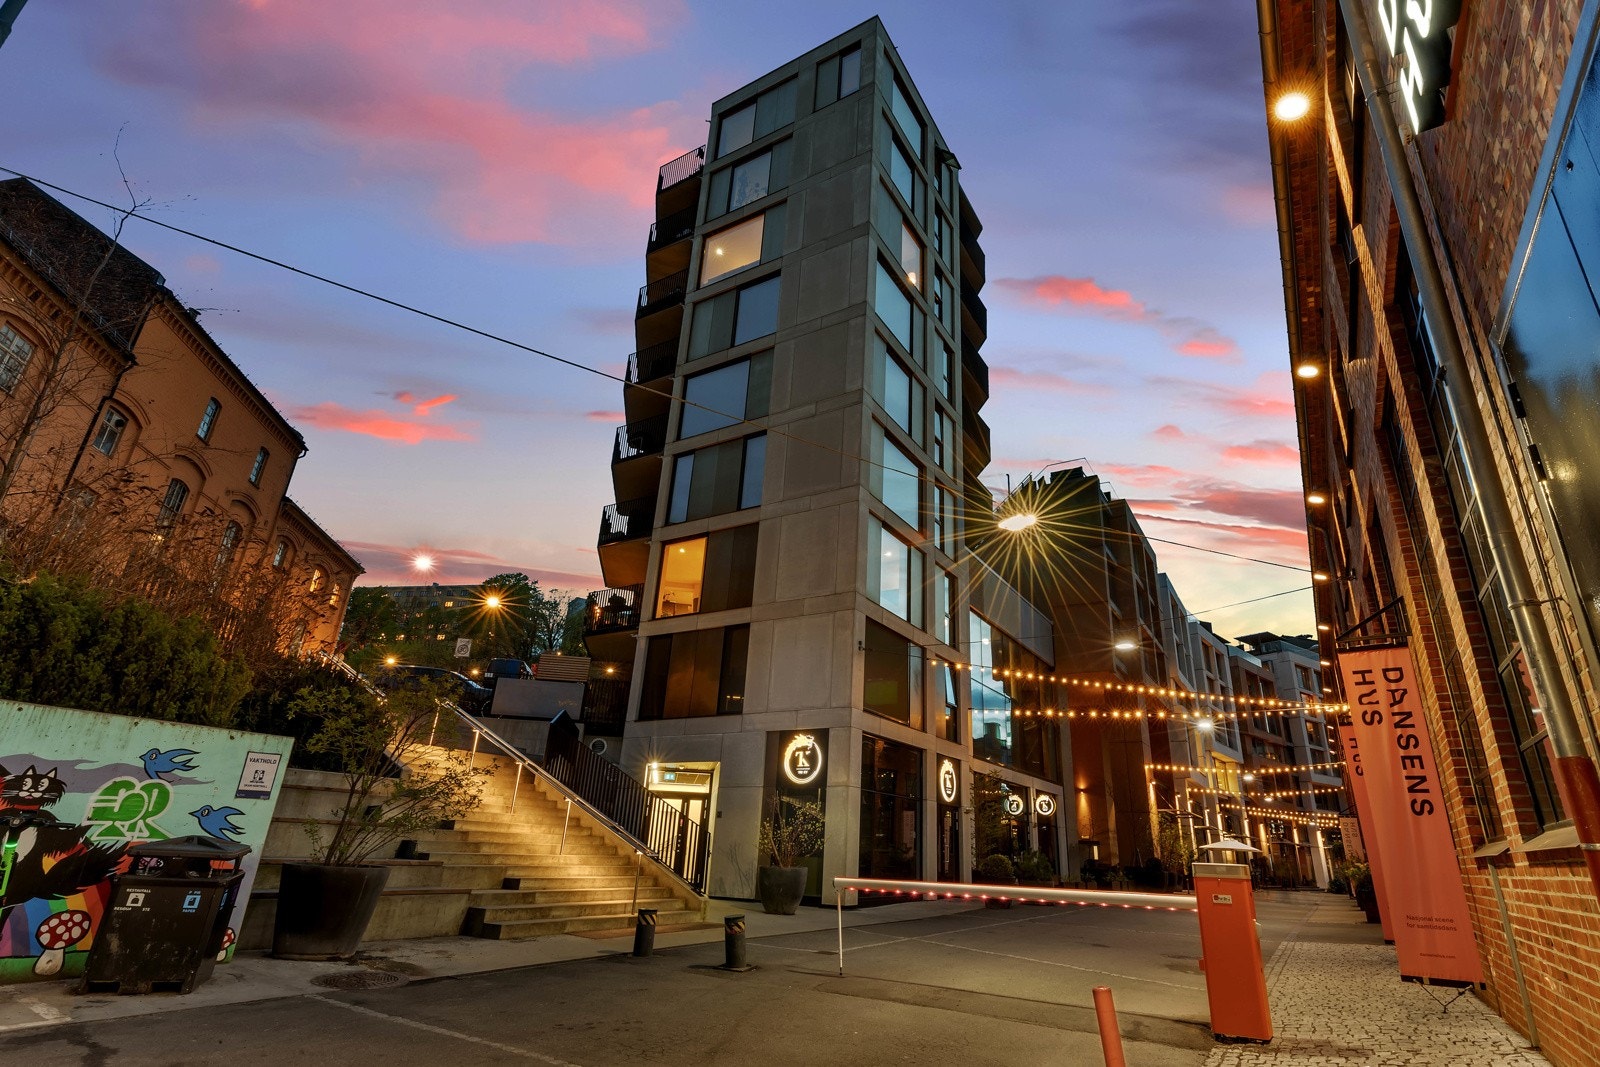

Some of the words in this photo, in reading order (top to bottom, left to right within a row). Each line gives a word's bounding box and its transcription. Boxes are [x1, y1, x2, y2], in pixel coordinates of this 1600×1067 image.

[1352, 669, 1383, 726] HUS
[249, 757, 277, 765] VAKTHOLD
[1382, 667, 1435, 817] DANSENS
